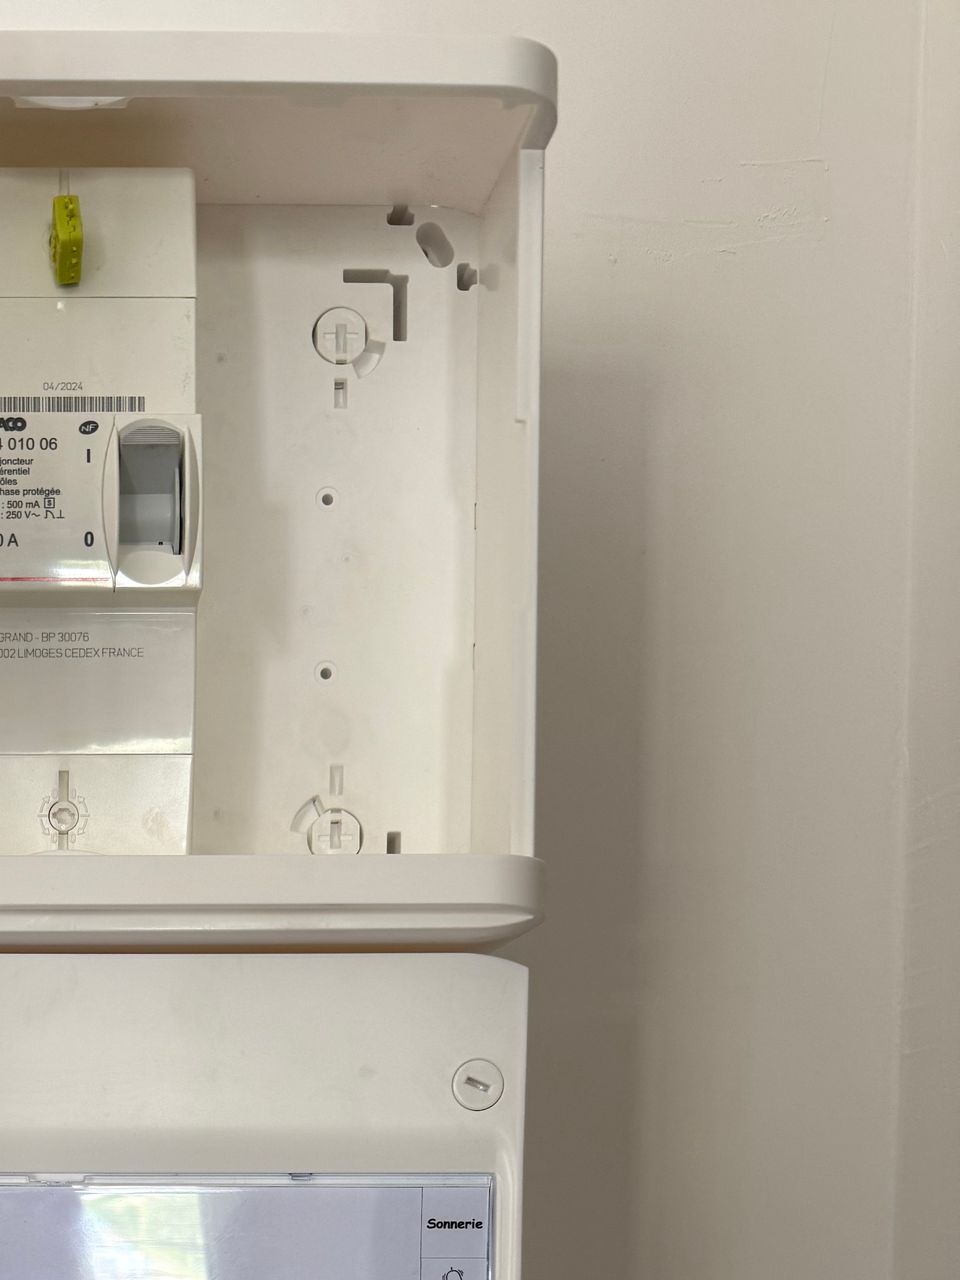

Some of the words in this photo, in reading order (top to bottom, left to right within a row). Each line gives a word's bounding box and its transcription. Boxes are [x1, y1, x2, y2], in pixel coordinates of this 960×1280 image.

[43, 381, 83, 392] 04/2024
[80, 422, 98, 433] NF
[8, 437, 35, 450] 010
[40, 437, 58, 450] 06
[23, 487, 61, 498] protégée
[7, 500, 23, 509] 500
[25, 500, 40, 509] mA
[6, 511, 22, 520] 250
[7, 533, 19, 548] A
[41, 632, 56, 643] BP
[58, 631, 90, 642] 30076
[17, 648, 63, 659] LIMOGES
[64, 648, 100, 658] CEDEX
[102, 647, 144, 658] FRANCE
[426, 1218, 483, 1229] Sonnerie
